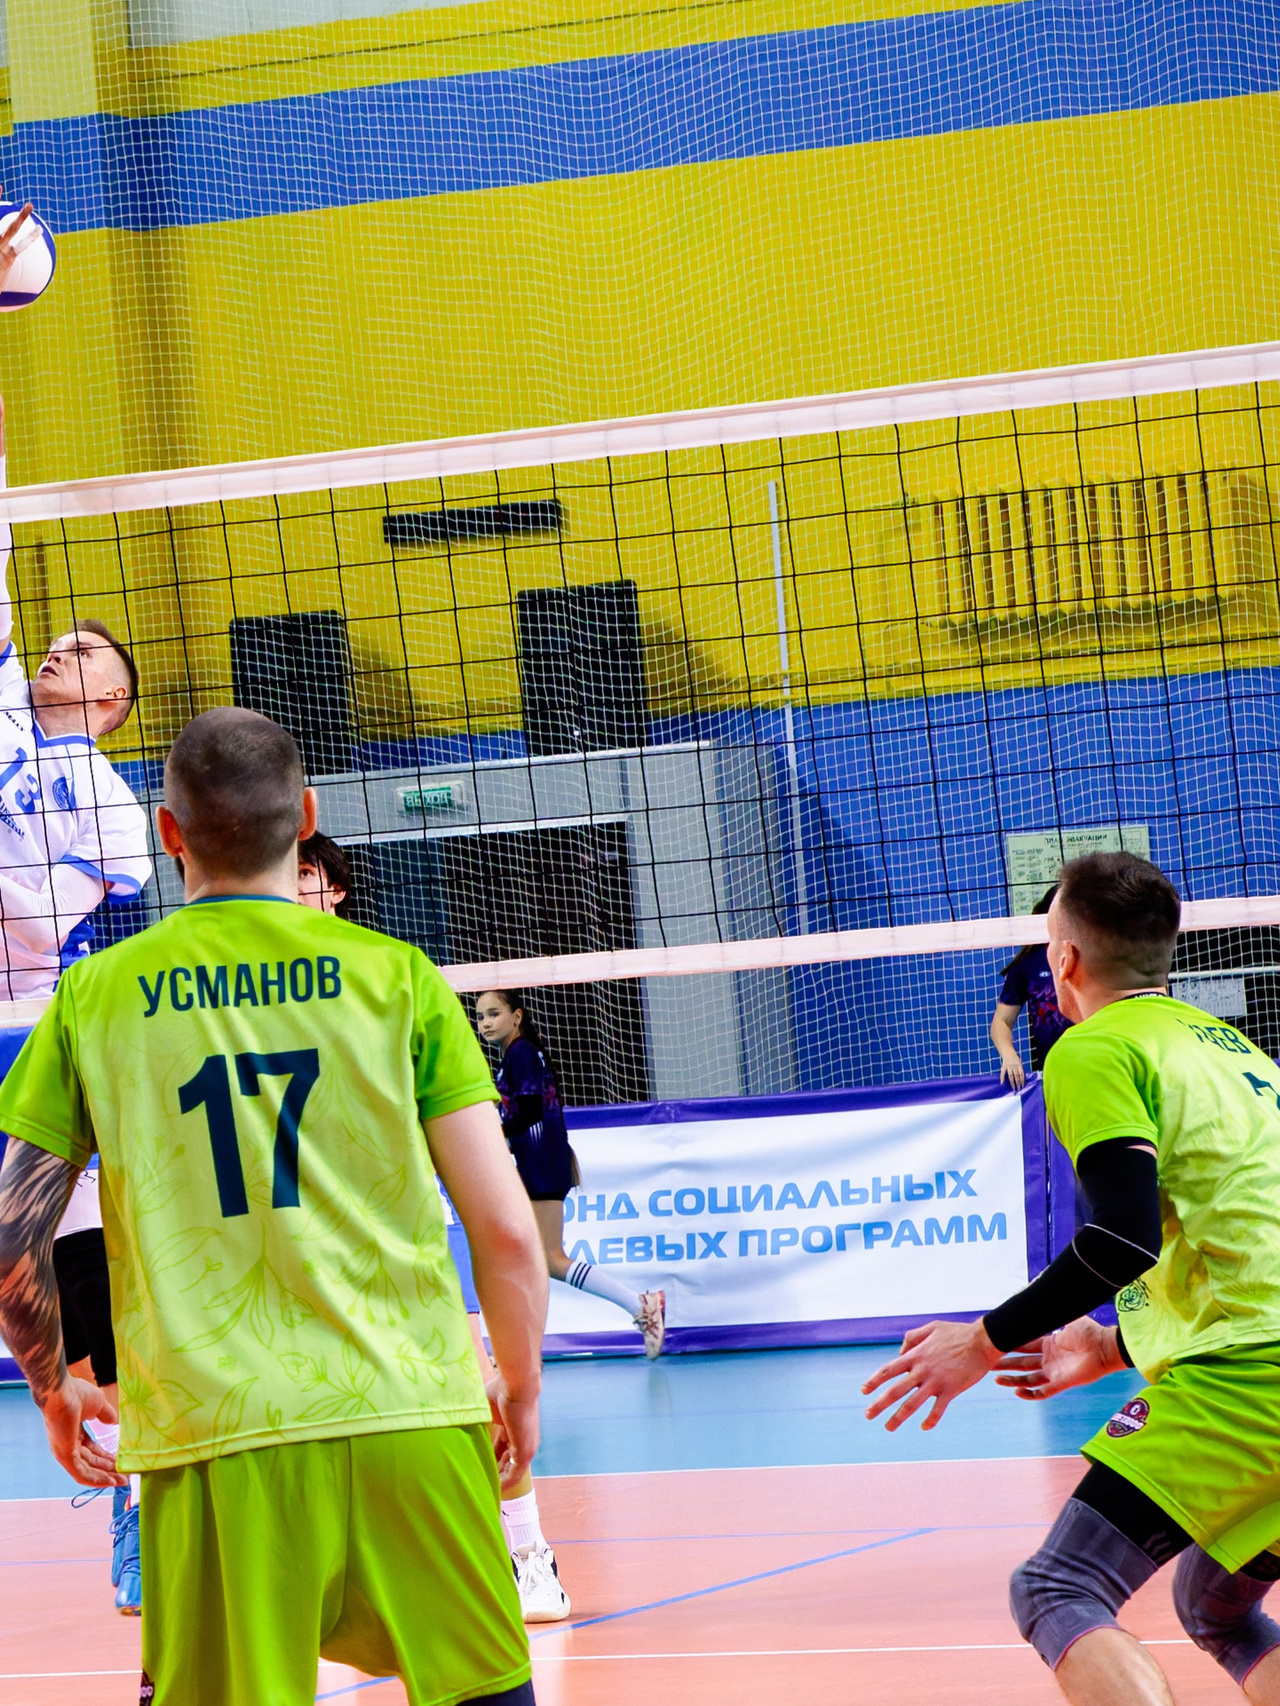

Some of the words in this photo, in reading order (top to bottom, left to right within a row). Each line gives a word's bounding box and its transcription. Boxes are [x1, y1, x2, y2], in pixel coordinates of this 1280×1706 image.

[137, 955, 342, 1018] УСМАНОВ
[178, 1048, 320, 1218] 17
[562, 1192, 640, 1223] ОНД
[648, 1169, 978, 1218] СОЦИАЛЬНЫХ
[563, 1231, 728, 1266] ЛЕВЫХ
[738, 1212, 1008, 1256] ПРОГРАММ
